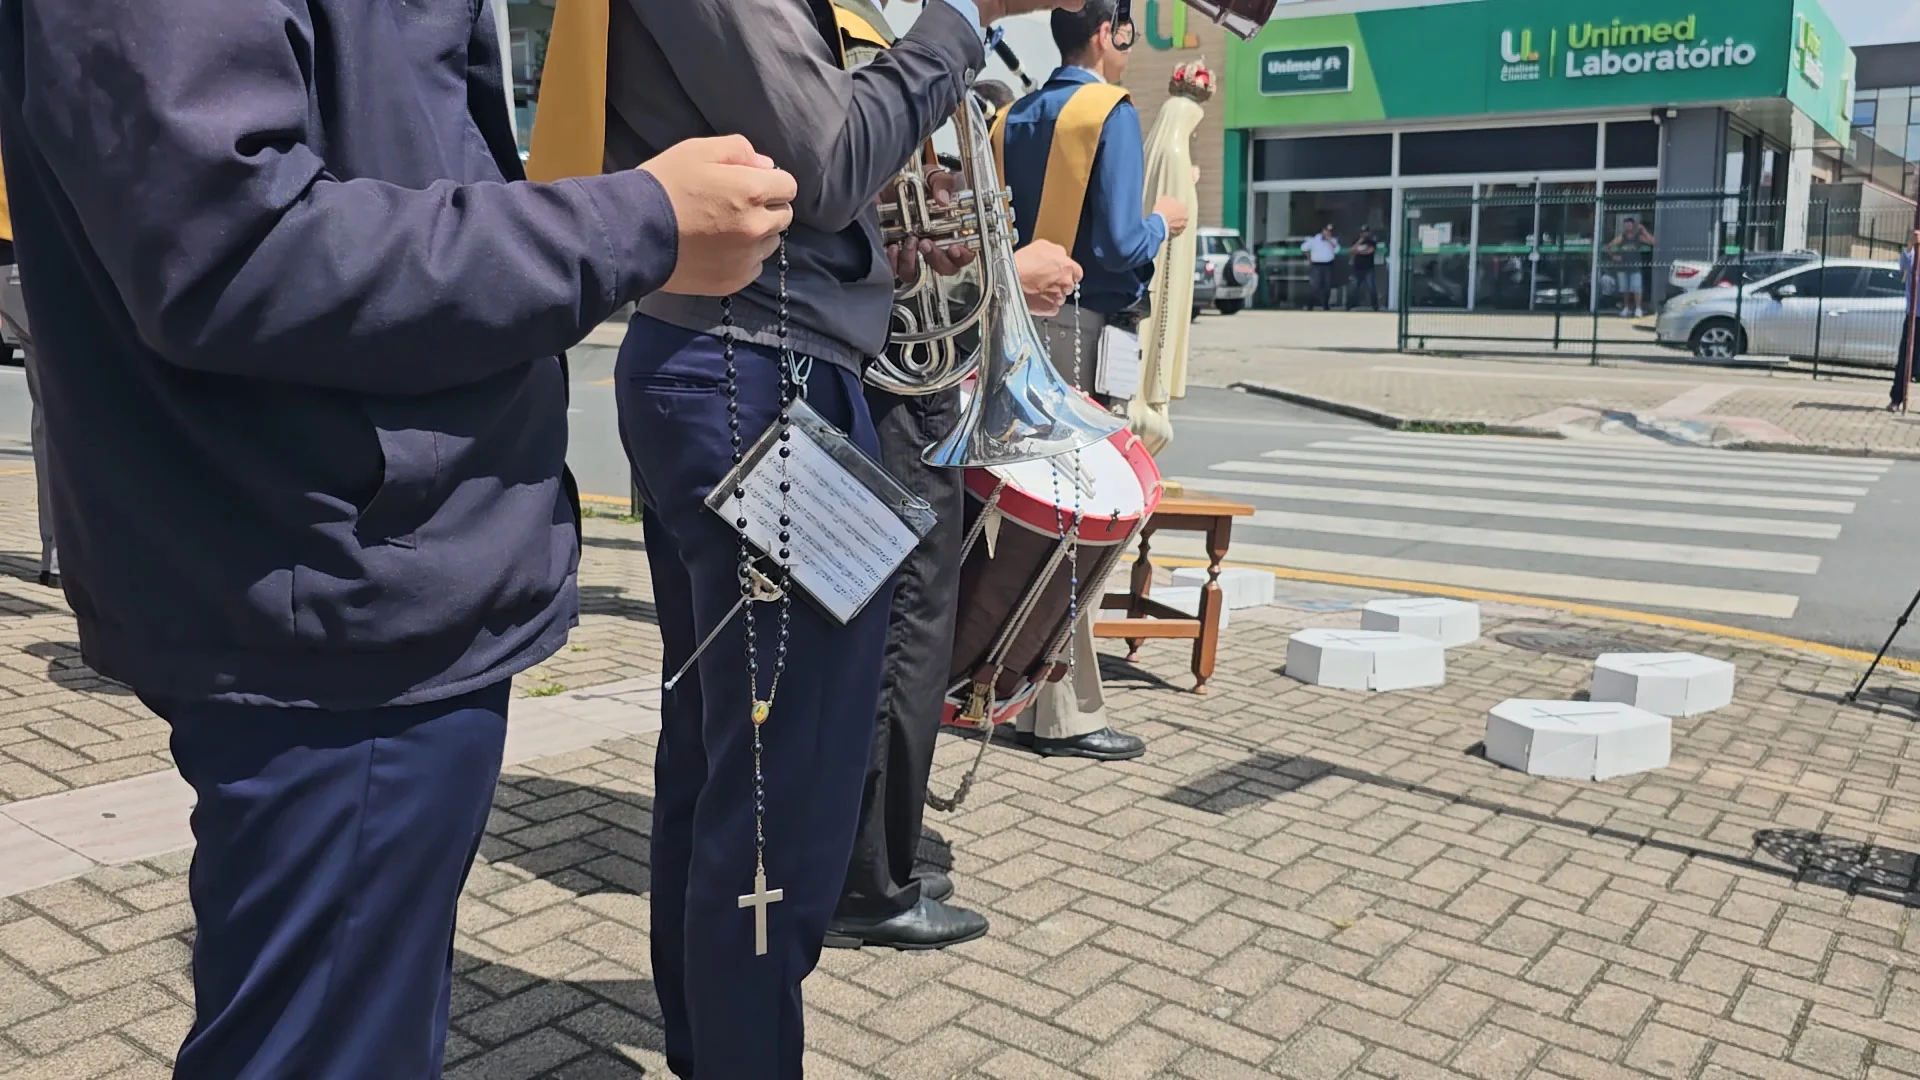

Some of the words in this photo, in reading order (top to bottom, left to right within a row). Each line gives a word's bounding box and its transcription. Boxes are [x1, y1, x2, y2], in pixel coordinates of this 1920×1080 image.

[1568, 14, 1696, 49] Unimed
[1268, 57, 1322, 74] Unimed
[1566, 37, 1756, 78] Laboratório
